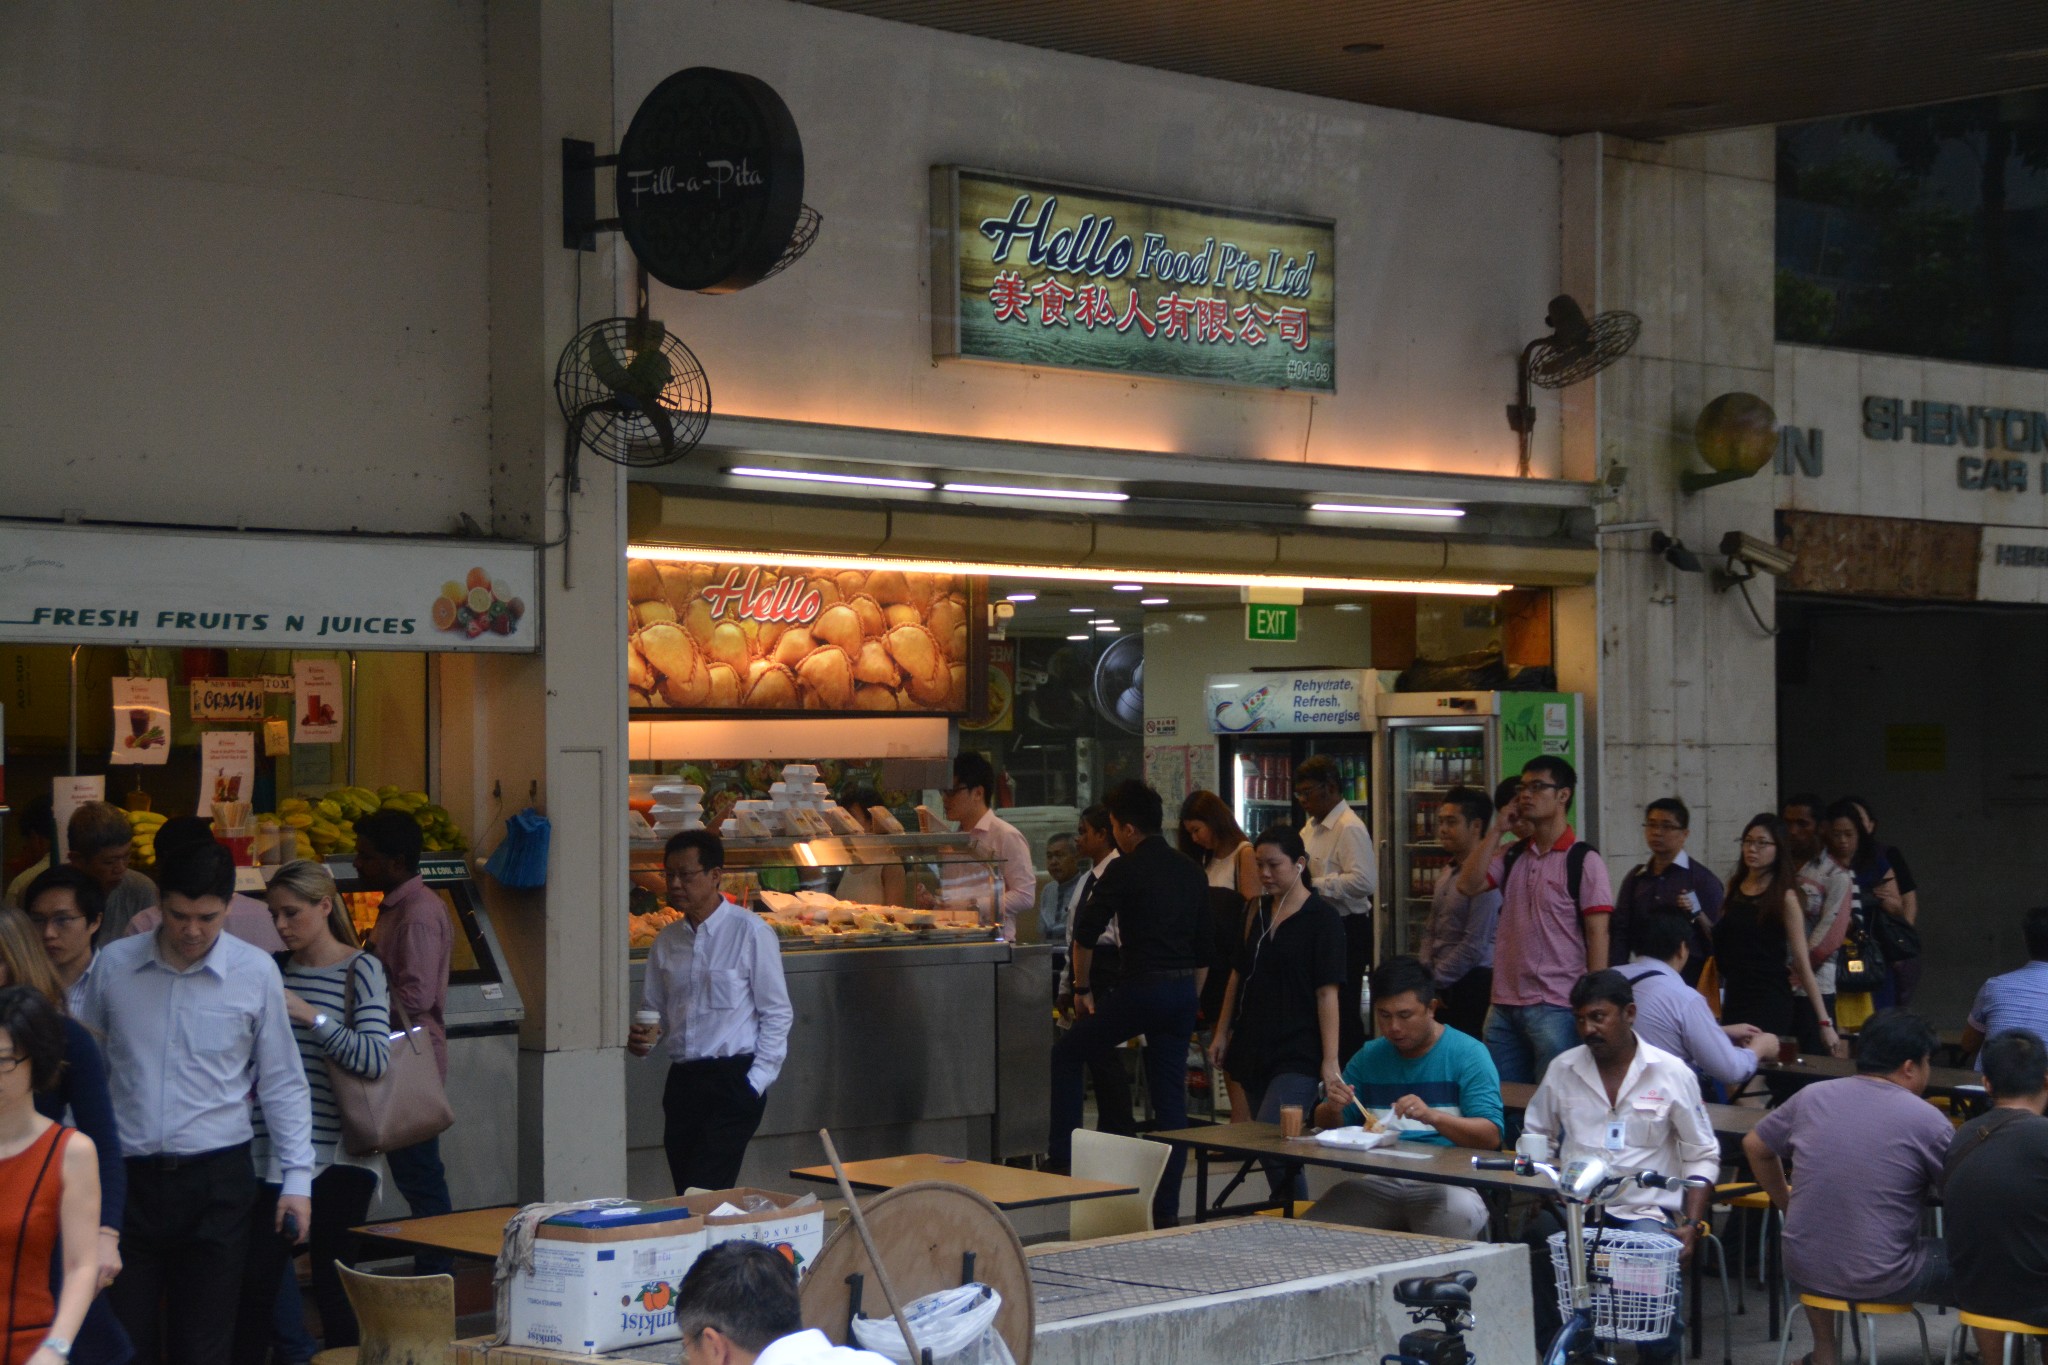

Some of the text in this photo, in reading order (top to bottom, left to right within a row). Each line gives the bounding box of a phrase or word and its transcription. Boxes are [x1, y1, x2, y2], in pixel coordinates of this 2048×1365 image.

[627, 157, 763, 208] Fill-a-Pita
[979, 194, 1316, 297] Hello Food Pte Ltd
[988, 269, 1310, 352] 美食私人有限公司
[1286, 360, 1331, 382] #01-03
[1957, 456, 2028, 492] CAR
[702, 565, 823, 623] Hello
[33, 607, 417, 636] FRESH FRUITS N JUICES
[1256, 609, 1288, 635] EXIT
[1293, 679, 1354, 694] Rehydrate,
[1293, 694, 1341, 708] Refresh,
[1293, 710, 1361, 725] Re-energise
[740, 1223, 808, 1241] ORANGES
[620, 1310, 678, 1338] unkist
[528, 1331, 563, 1345] Sunkist
